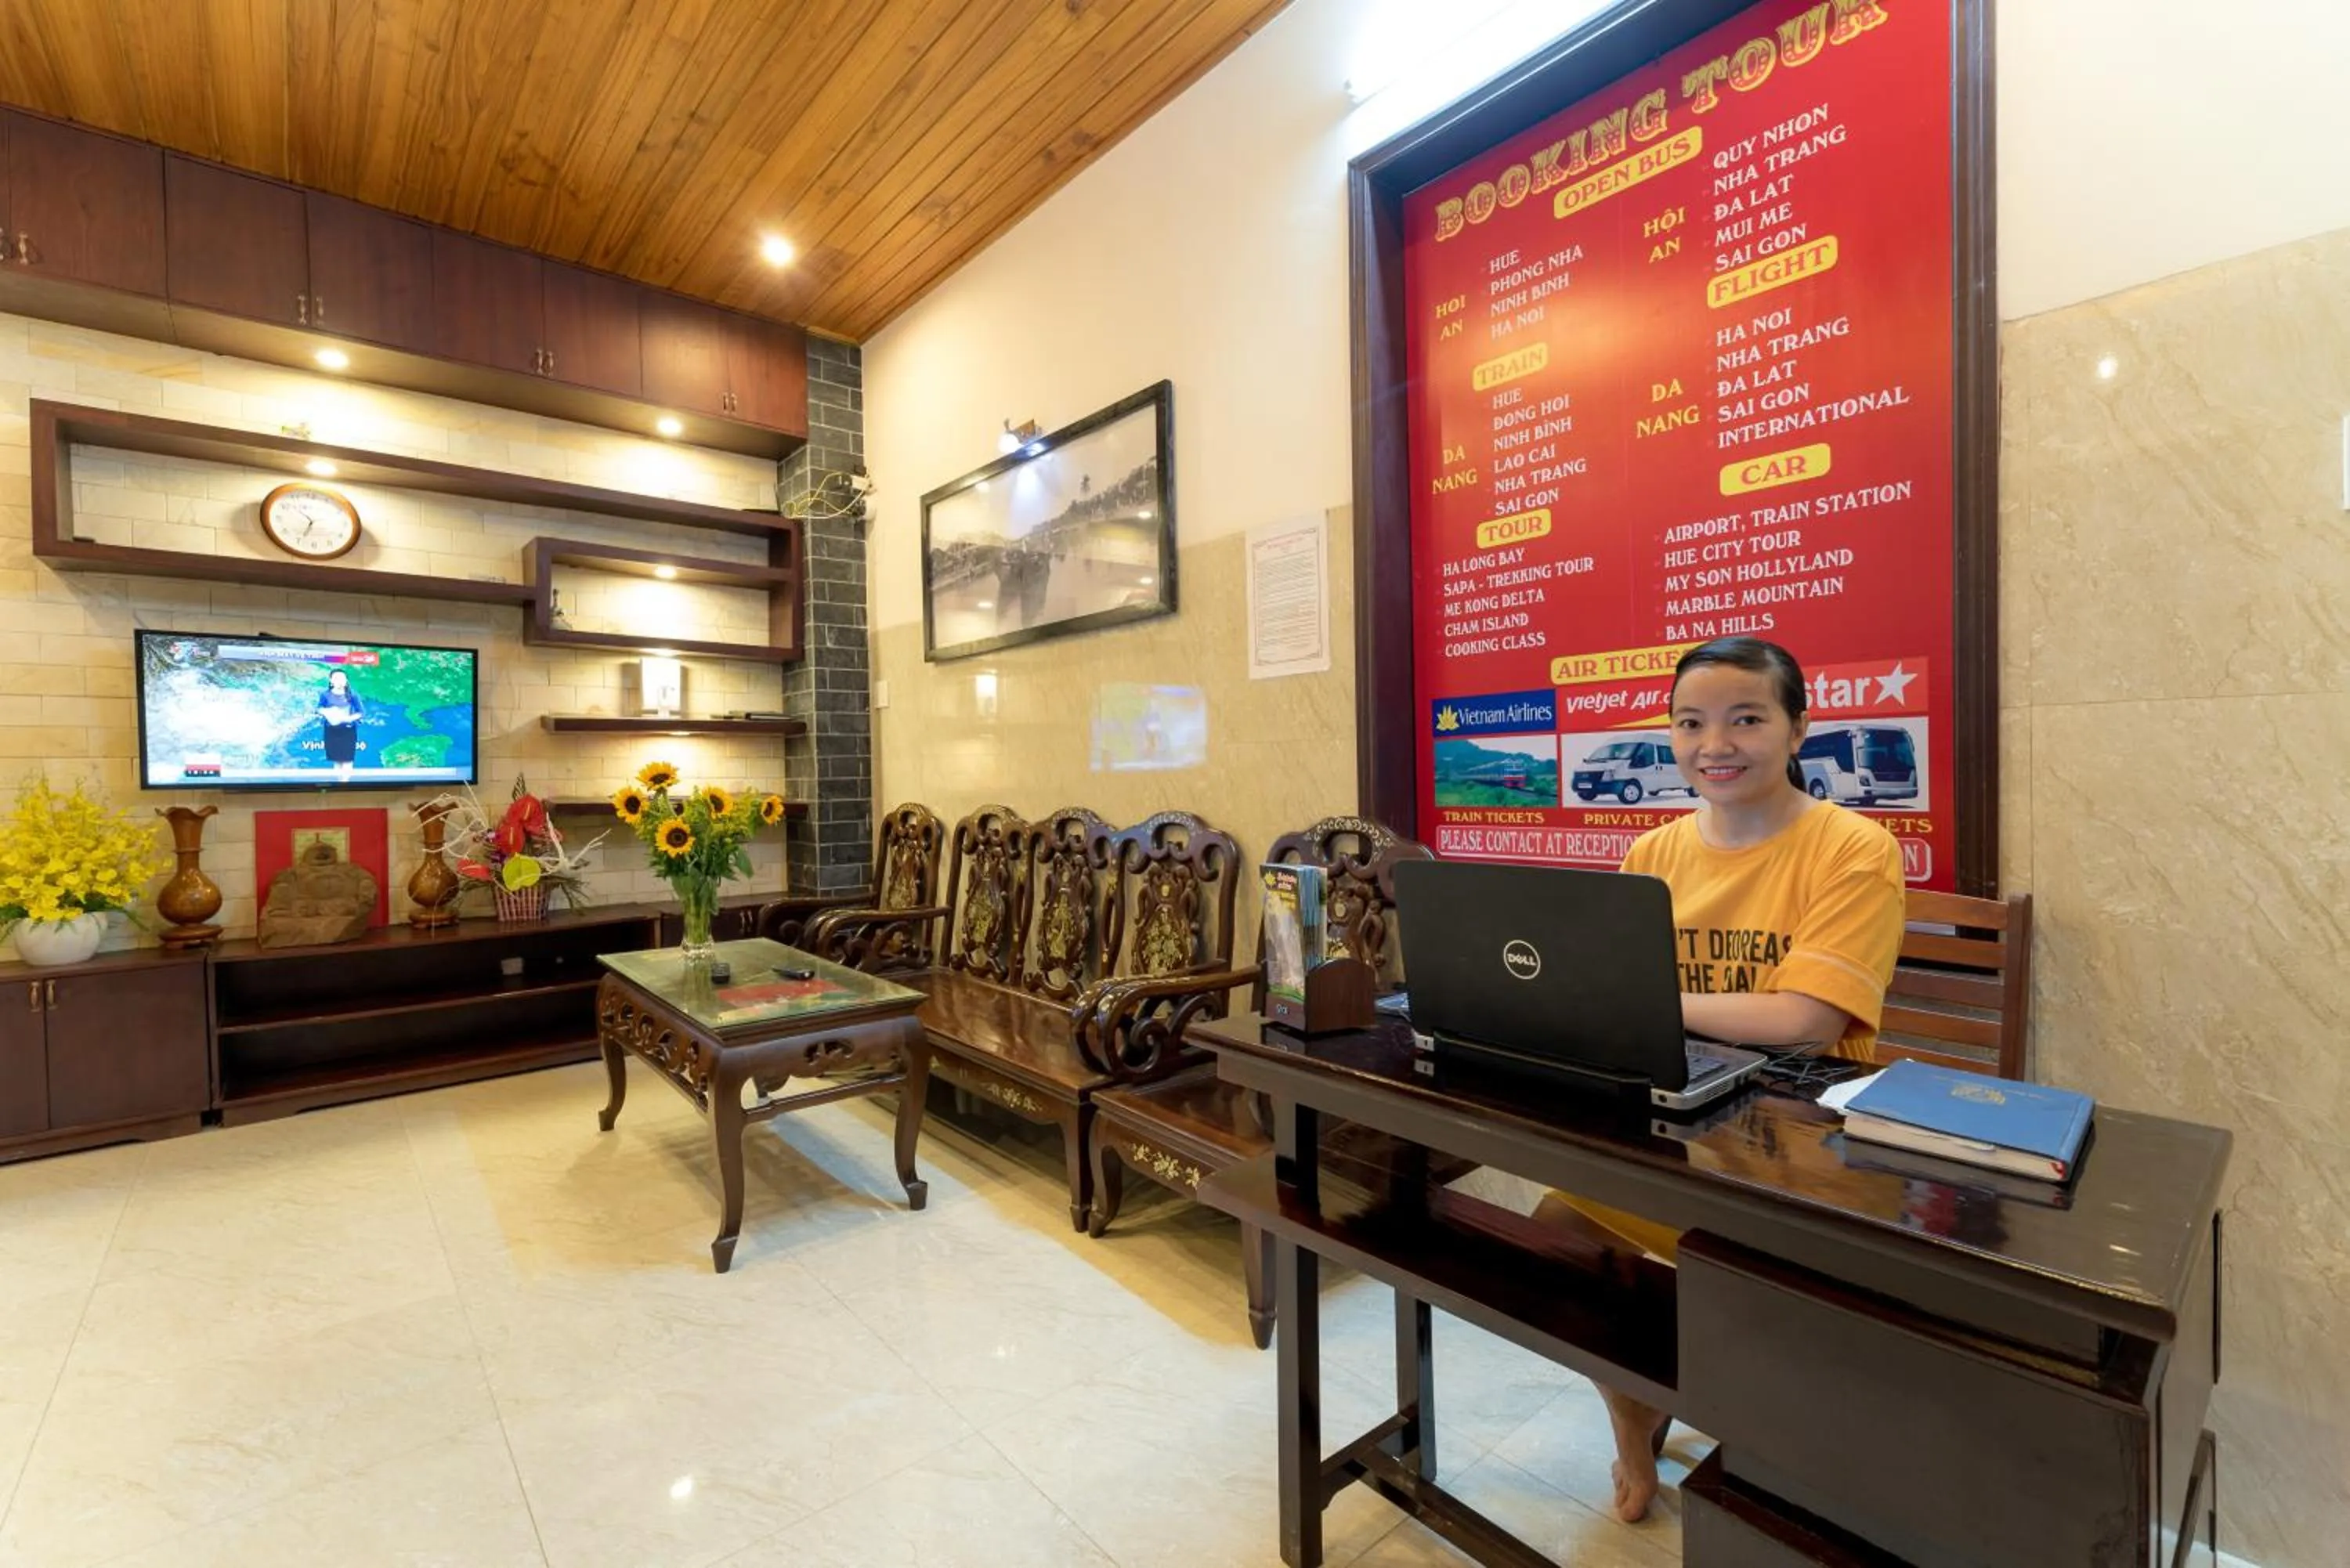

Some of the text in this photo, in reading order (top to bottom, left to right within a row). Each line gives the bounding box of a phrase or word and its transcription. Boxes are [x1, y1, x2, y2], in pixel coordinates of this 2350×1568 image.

[1434, 0, 1889, 242] BOOKING TOUR
[1713, 103, 1829, 169] QUY NHON
[1564, 135, 1691, 209] OPEN BUS
[1714, 124, 1847, 197] NHA TRANG
[1750, 173, 1794, 207] LAT
[1715, 201, 1793, 247] MUI ME
[1490, 249, 1520, 274] HUE
[1649, 237, 1681, 264] AN
[1715, 222, 1807, 273] SAI GON
[1491, 244, 1584, 295] PHONG NHA
[1714, 244, 1830, 304] FLIGHT
[1435, 294, 1466, 320] HOI
[1491, 271, 1570, 317] NINH BINH
[1439, 318, 1463, 341] AN
[1491, 305, 1544, 341] HA NOI
[1716, 308, 1792, 347] HA NOI
[1716, 316, 1849, 372] NHA TRANG
[1477, 349, 1543, 386] TRAIN
[1752, 359, 1798, 388] LAT
[1492, 388, 1523, 410] HUE
[1540, 393, 1571, 417] HOI
[1651, 378, 1683, 403] DA
[1716, 382, 1811, 424] SAI GON
[1636, 403, 1701, 439] NANG
[1717, 385, 1909, 449] INTERNATIONAL
[1443, 445, 1466, 464] DA
[1493, 428, 1530, 452] NINH
[1494, 455, 1524, 474] LAO
[1495, 457, 1587, 495] NHA TRANG
[1741, 454, 1807, 486] CAR
[1432, 468, 1478, 494] NANG
[1495, 487, 1560, 516] SAI GON
[1664, 481, 1913, 544] AIRPORT, TRAIN STATION
[1485, 516, 1544, 541] TOUR
[1443, 548, 1526, 576] HA LONG BAY
[1664, 529, 1802, 569] HUE CITY TOUR
[1444, 583, 1476, 597] SAPA
[1487, 564, 1552, 587] TREKKING
[1555, 557, 1595, 576] TOUR
[1665, 548, 1854, 593] MY SON HOLLYLAND
[1444, 588, 1546, 617] ME KONG DELTA
[1665, 576, 1844, 617] MARBLE MOUNTAIN
[1444, 612, 1529, 638] CHAM ISLAND
[1666, 612, 1775, 641] BA NA HILLS
[1444, 631, 1546, 658] COOKING CLASS
[1556, 659, 1599, 679] AIR
[1459, 702, 1553, 726] Vietnam Airlines
[1443, 811, 1545, 823] TRAIN TICKETS
[1585, 814, 1655, 826] PRIVATE
[1878, 818, 1933, 833] ETS
[1441, 829, 1637, 858] PLEASE CONTACT AT RECEPTIO
[1507, 953, 1537, 966] DELL
